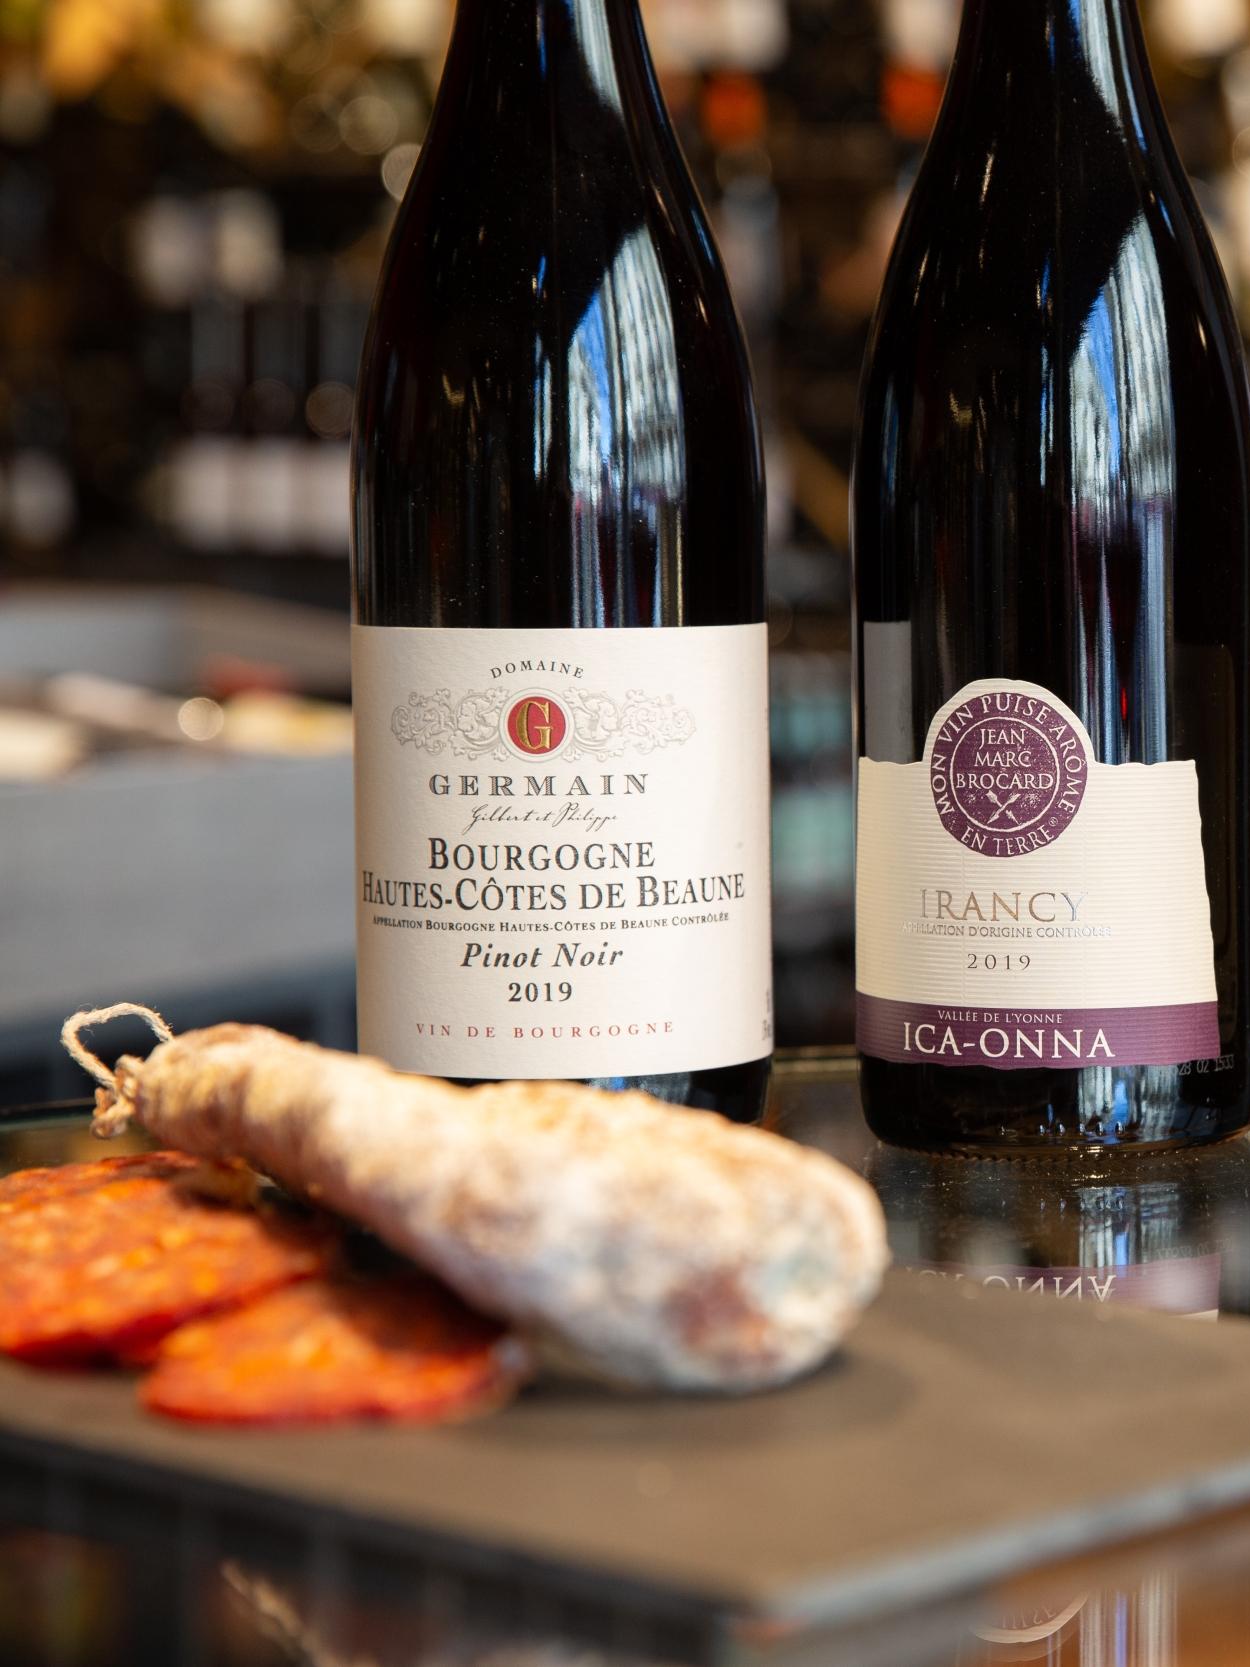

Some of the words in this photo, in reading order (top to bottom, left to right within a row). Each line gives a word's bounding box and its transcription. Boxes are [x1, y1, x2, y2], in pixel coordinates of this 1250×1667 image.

[490, 660, 584, 679] DOMAINE
[980, 693, 1051, 725] PUISE
[516, 701, 554, 751] G
[938, 705, 974, 743] VIN
[979, 728, 1026, 750] JEAN
[974, 751, 1032, 768] MARC
[1049, 723, 1086, 815] ARÔME
[428, 773, 650, 797] GERMAIN
[932, 753, 955, 816] MON
[956, 773, 1054, 790] BROCARD
[462, 803, 537, 836] Gilbert
[535, 809, 554, 823] et
[552, 801, 618, 833] Philippe
[961, 826, 988, 851] EN
[428, 837, 656, 871] BOURGOGNE
[362, 869, 567, 912] HAUTES-CÔTES
[578, 882, 626, 910] DE
[636, 873, 745, 908] BEAUNE
[920, 888, 1089, 922] IRANCY
[425, 920, 495, 932] BOURGOGNE
[500, 920, 596, 932] HAUTES-CÔTES
[601, 921, 617, 931] DE
[621, 918, 668, 930] BEAUNE
[968, 926, 1032, 938] D'ORIGINE
[460, 943, 543, 968] Pinot
[552, 942, 624, 968] Noir
[967, 953, 1031, 970] 2019
[508, 982, 574, 1003] 2019
[938, 1009, 981, 1023] VALLÉE
[983, 1012, 1000, 1023] DE
[1005, 1012, 1063, 1024] L'YONNE
[416, 1022, 452, 1037] VIN
[467, 1024, 496, 1038] DE
[514, 1021, 674, 1039] BOURGOGNE
[903, 1022, 1115, 1059] ICA-ONNA
